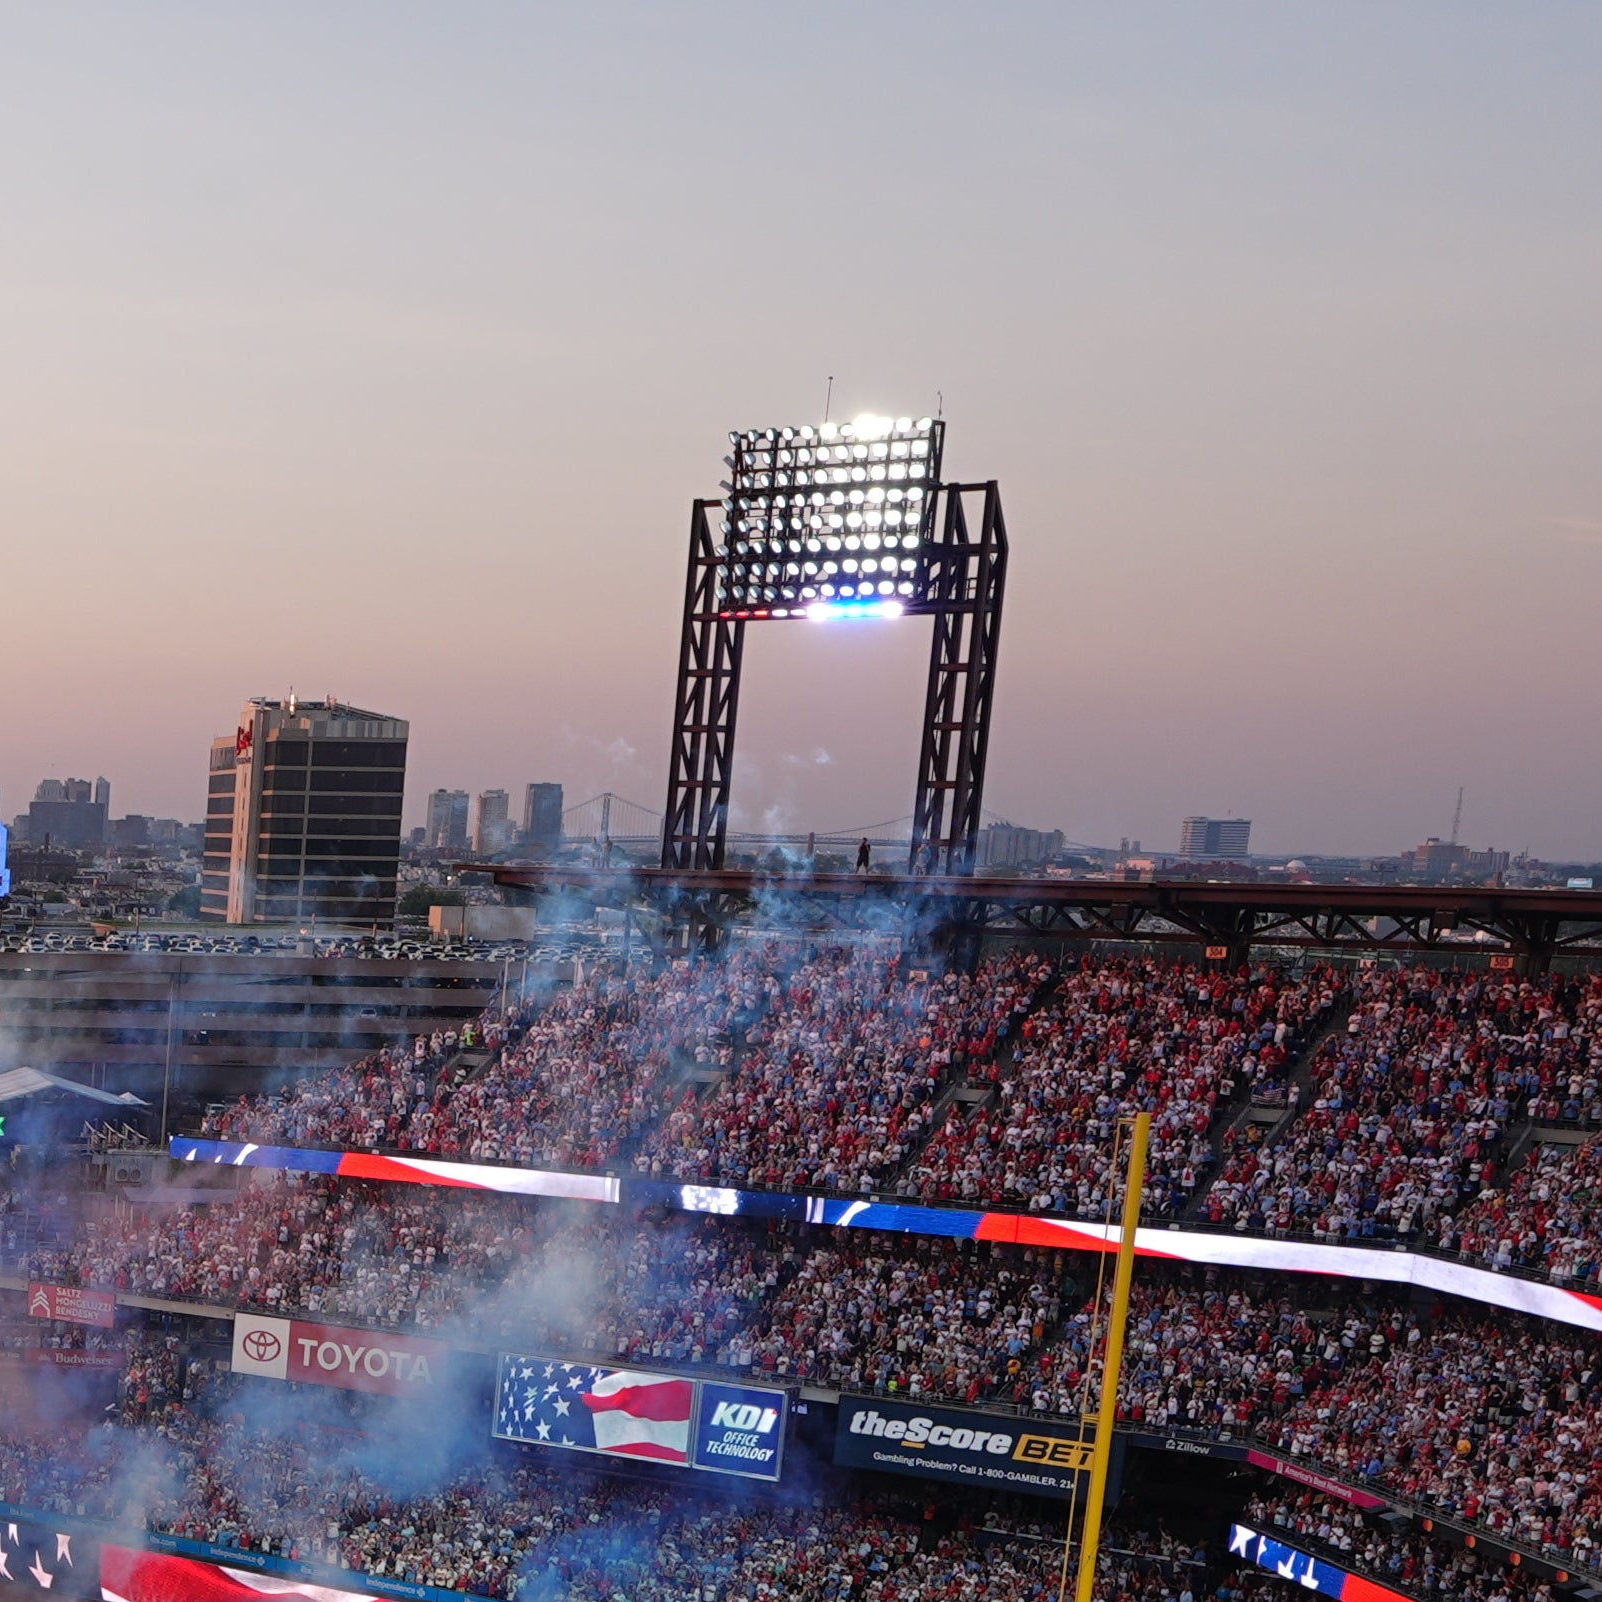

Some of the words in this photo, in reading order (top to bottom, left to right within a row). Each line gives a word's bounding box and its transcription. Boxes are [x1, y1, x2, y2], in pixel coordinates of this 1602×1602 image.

[56, 1287, 82, 1298] SALTZ
[55, 1297, 112, 1312] MONGELUZZI
[55, 1306, 100, 1320] BENDESKY
[55, 1353, 114, 1366] Budweiser
[298, 1338, 434, 1384] TOYOTA
[710, 1401, 779, 1433] KDI
[723, 1430, 759, 1448] OFFICE
[849, 1410, 1012, 1454] theScore
[1021, 1438, 1094, 1465] BET
[706, 1440, 774, 1463] TECHNOLOGY
[1177, 1440, 1210, 1455] Zillow
[873, 1451, 915, 1468] Gambling
[916, 1456, 958, 1473] Problem?
[959, 1463, 977, 1475] Call
[1285, 1465, 1314, 1485] America's
[1313, 1475, 1326, 1489] Best
[1326, 1479, 1352, 1499] Network
[210, 1547, 257, 1564] Independence
[365, 1577, 416, 1595] Independence
